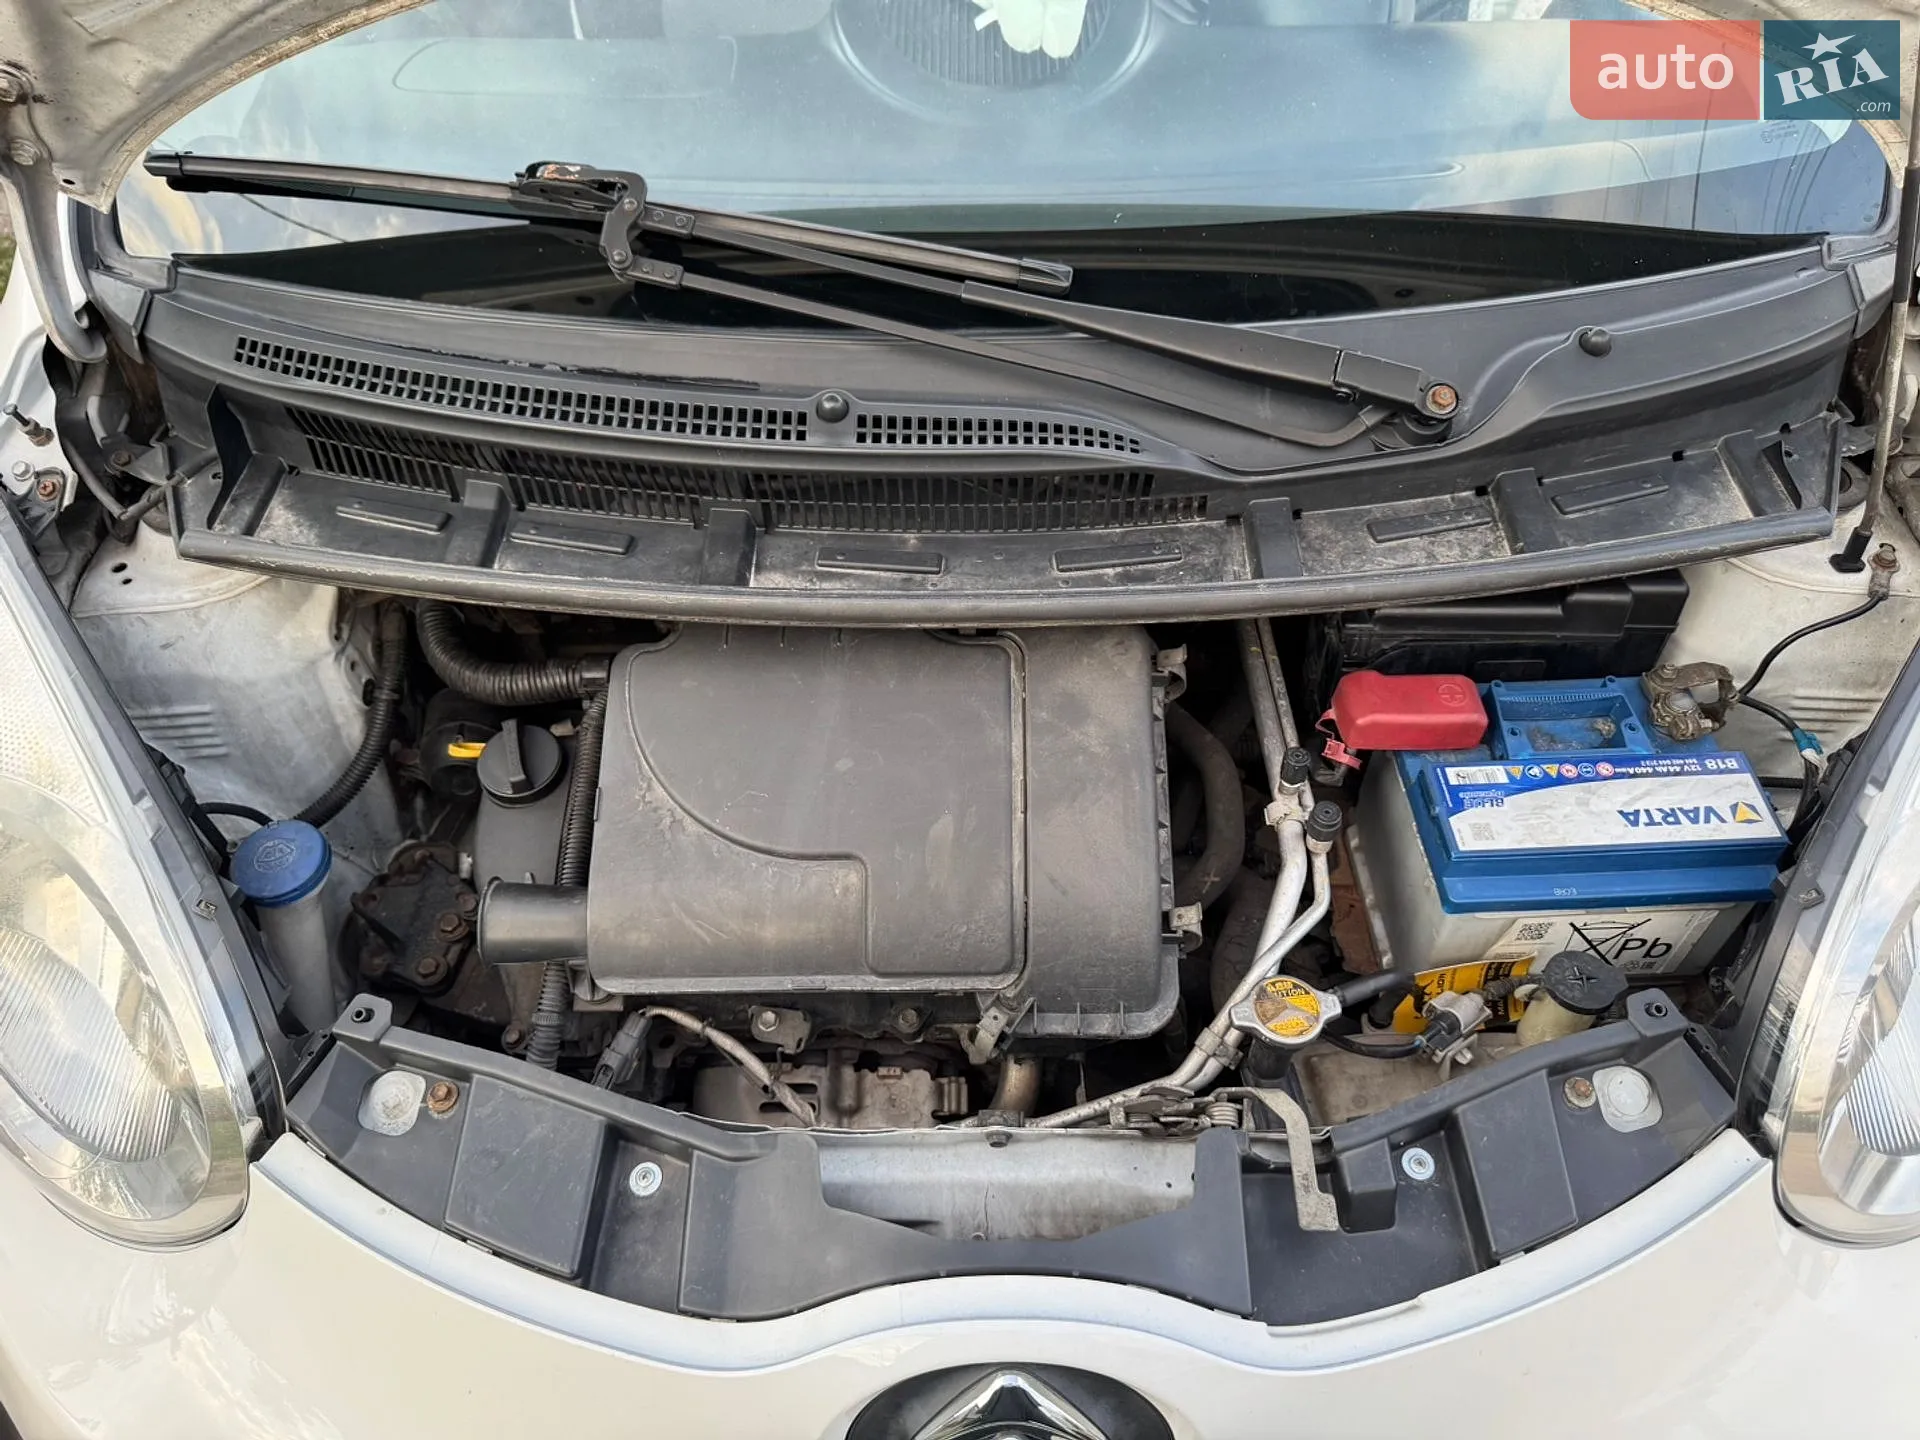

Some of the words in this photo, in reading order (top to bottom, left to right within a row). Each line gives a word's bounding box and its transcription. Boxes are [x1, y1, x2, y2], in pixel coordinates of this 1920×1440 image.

[1704, 757, 1740, 770] B18
[1616, 805, 1728, 828] VARTA
[1612, 937, 1673, 960] Pb
